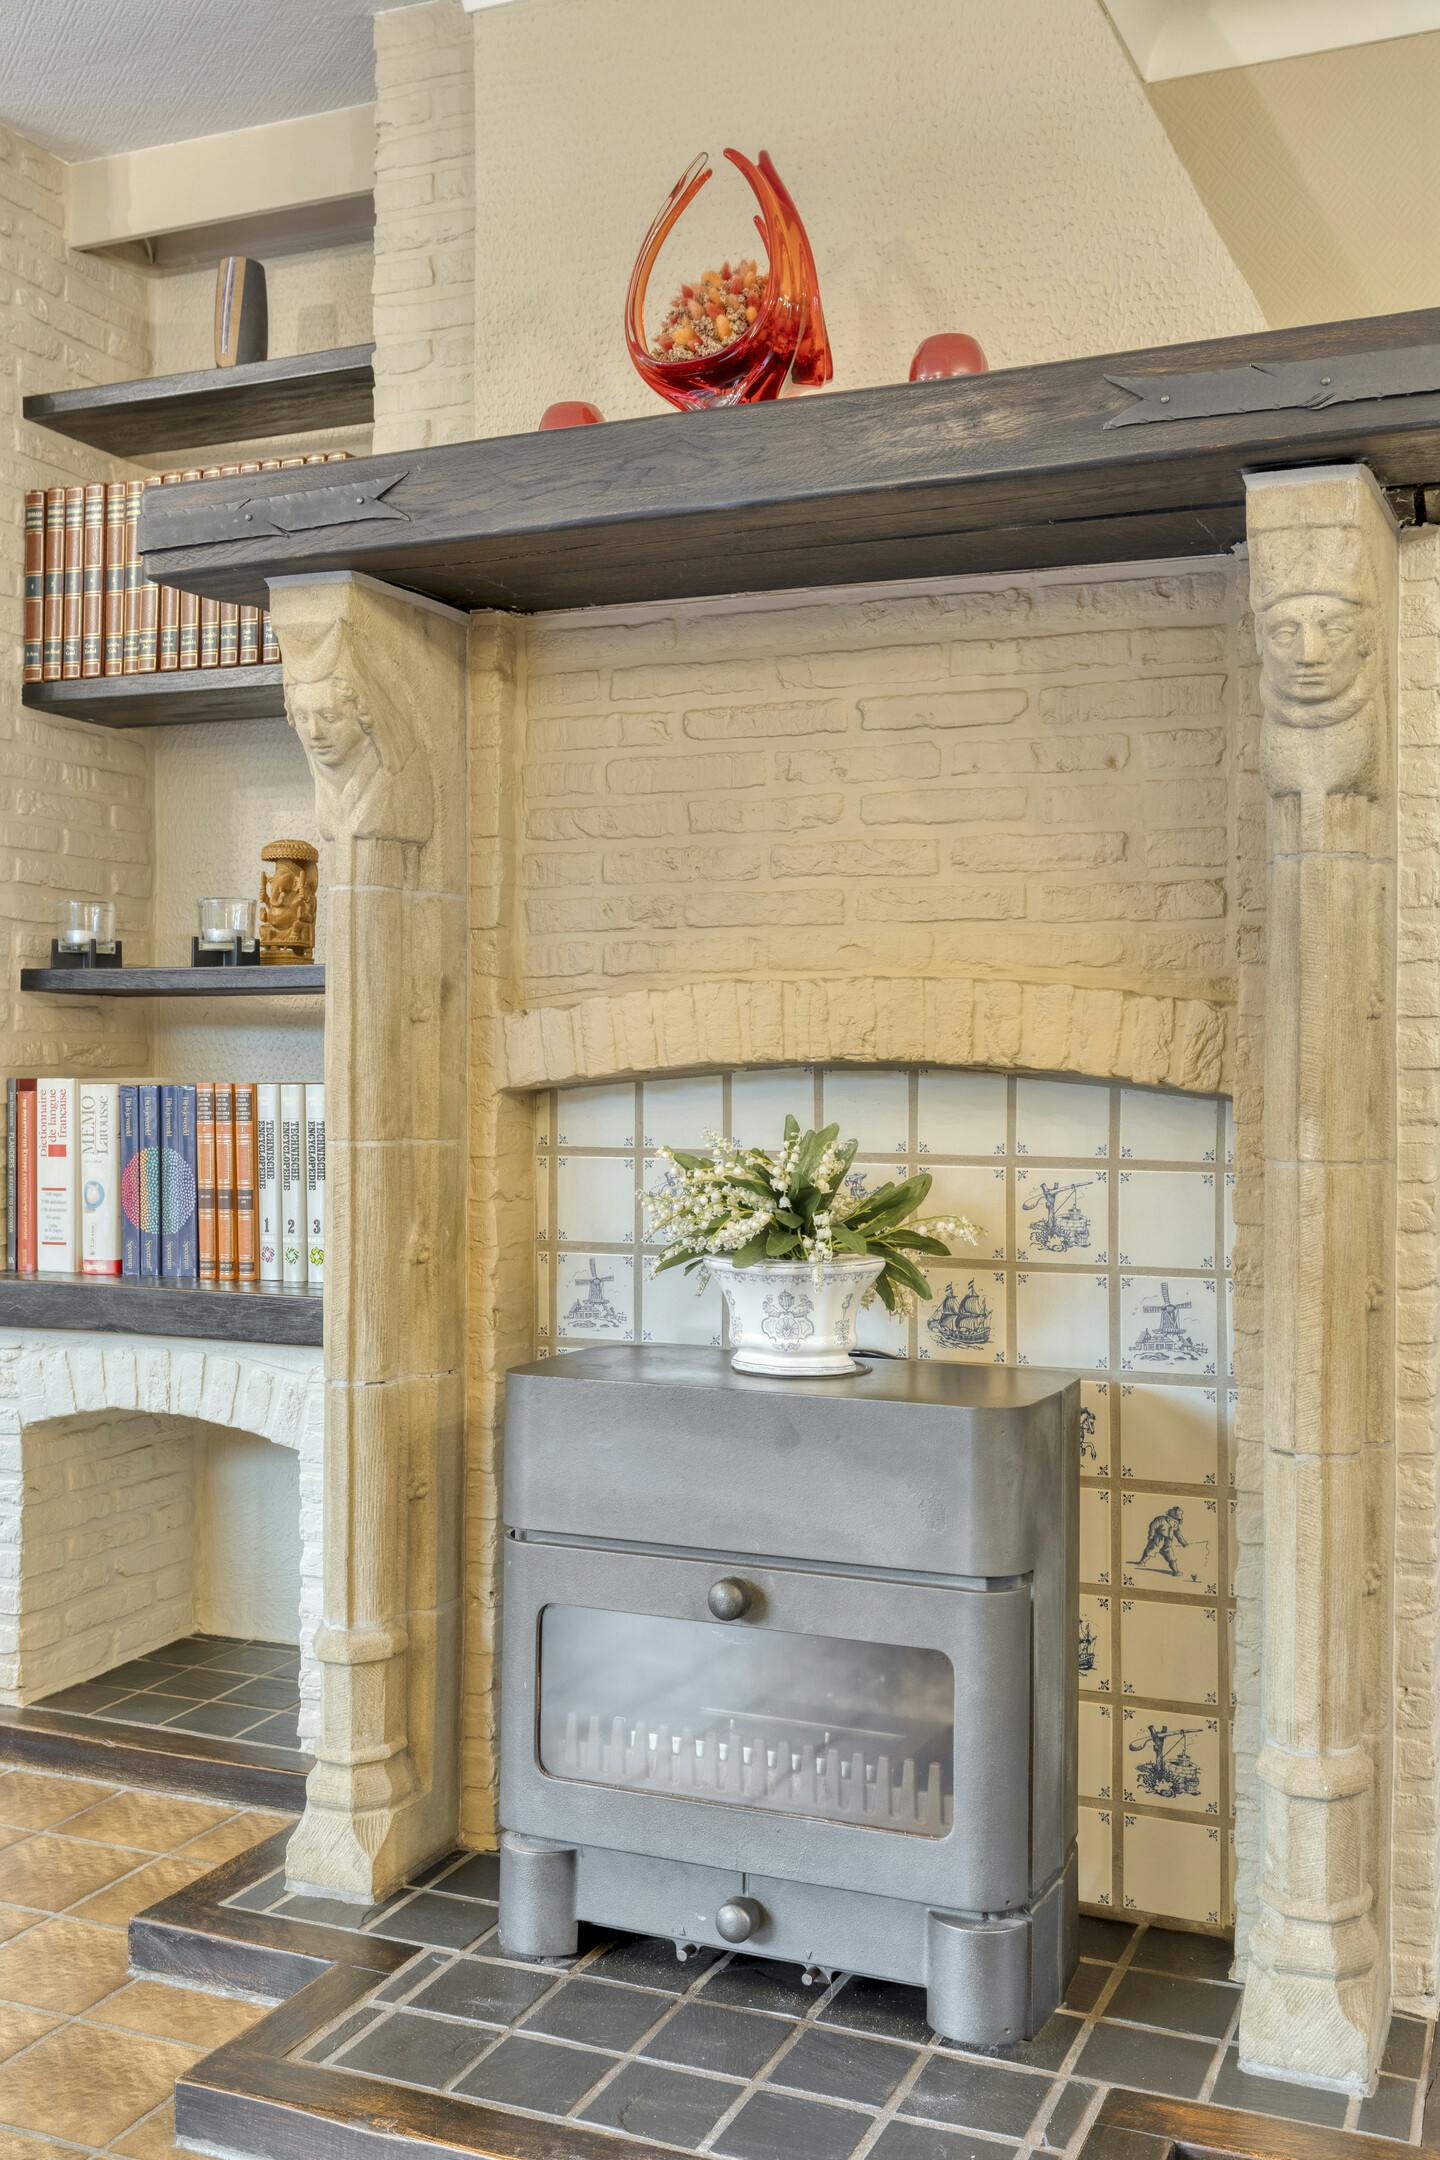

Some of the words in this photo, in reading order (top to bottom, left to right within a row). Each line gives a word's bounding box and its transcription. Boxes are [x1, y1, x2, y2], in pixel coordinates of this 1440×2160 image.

[47, 1088, 59, 1126] langue
[58, 1088, 67, 1138] française
[96, 1096, 108, 1153] Larousse
[47, 1129, 57, 1143] de
[258, 1120, 266, 1189] ENCYCLOPEDIE
[266, 1120, 275, 1180] TECHNISCHE
[291, 1121, 300, 1181] TECHNISCHE
[308, 1121, 316, 1191] ENCYCLOPEDIE
[316, 1121, 326, 1181] TECHNISCHE
[264, 1217, 270, 1233] 1
[288, 1218, 295, 1234] 2
[313, 1218, 321, 1234] 3
